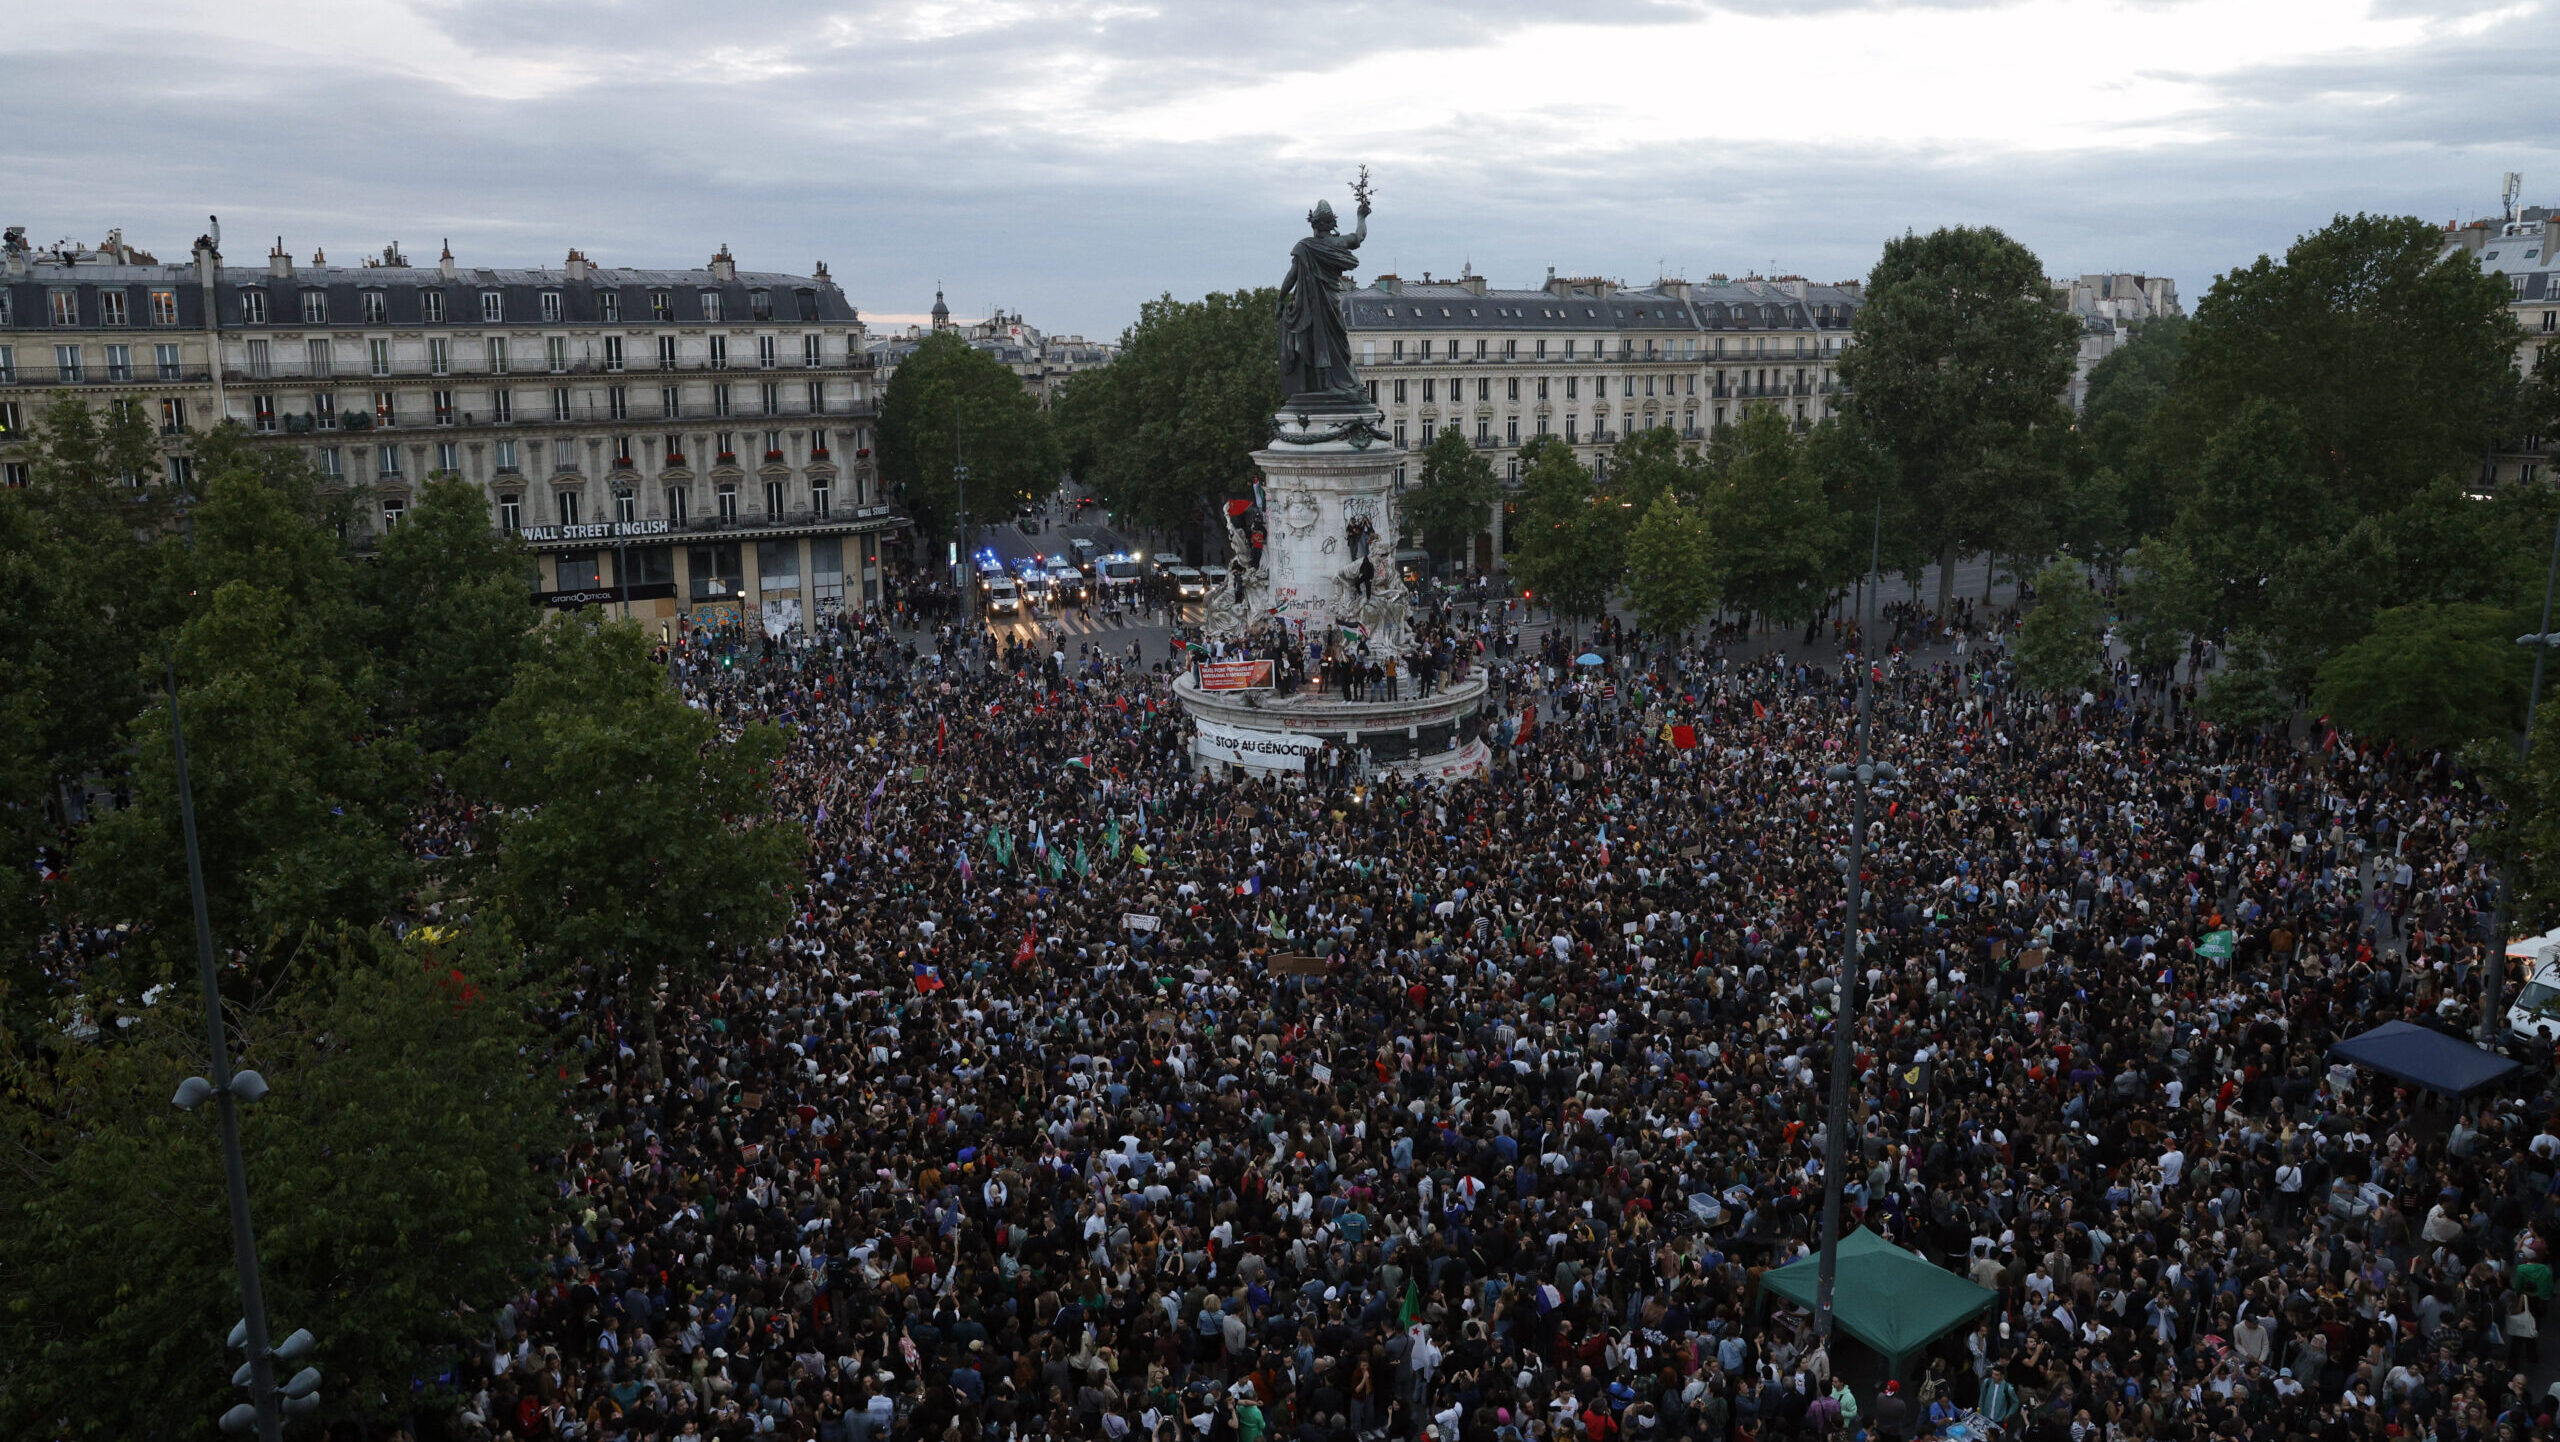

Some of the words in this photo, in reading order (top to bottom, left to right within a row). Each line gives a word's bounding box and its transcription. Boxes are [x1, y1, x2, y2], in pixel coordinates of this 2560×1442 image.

[521, 527, 558, 541] WALL
[563, 524, 610, 539] STREET
[614, 520, 669, 536] ENGLISH
[1216, 736, 1239, 749] STOP
[1241, 740, 1255, 751] AU
[1257, 741, 1317, 757] GÉNOCID
